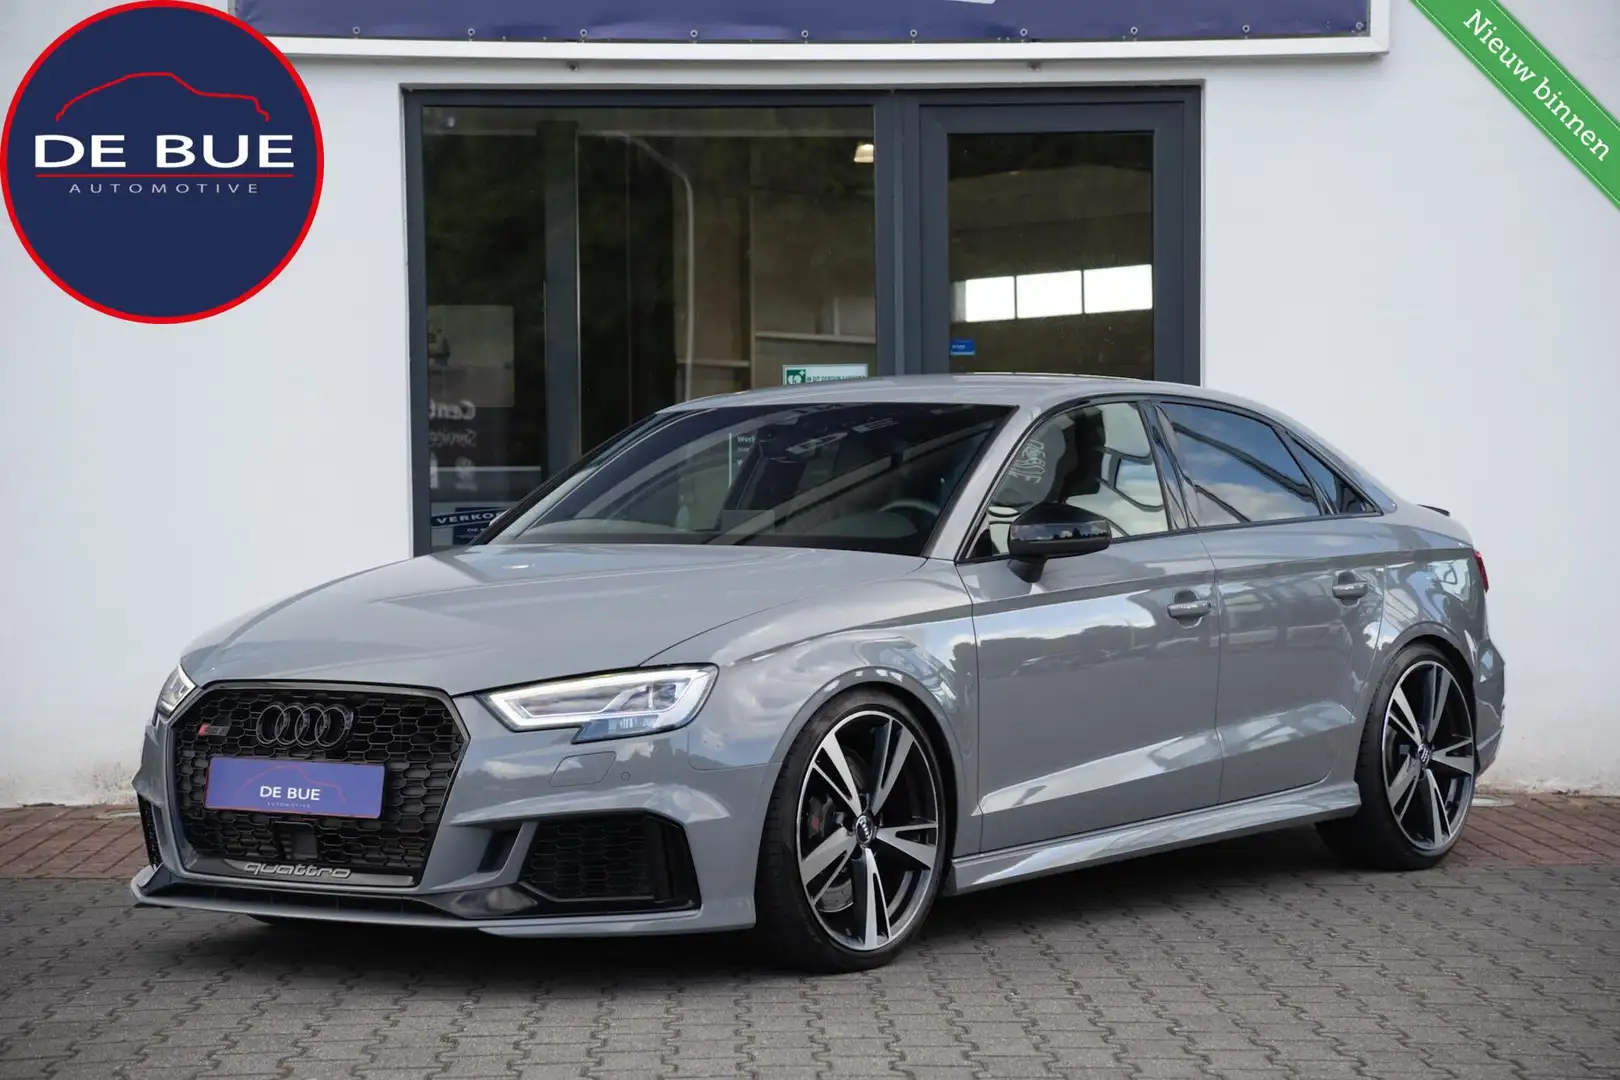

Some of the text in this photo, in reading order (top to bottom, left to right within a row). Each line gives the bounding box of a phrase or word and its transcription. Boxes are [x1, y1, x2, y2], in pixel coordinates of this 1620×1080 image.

[259, 785, 321, 801] DE BUE
[243, 862, 352, 879] quattro
